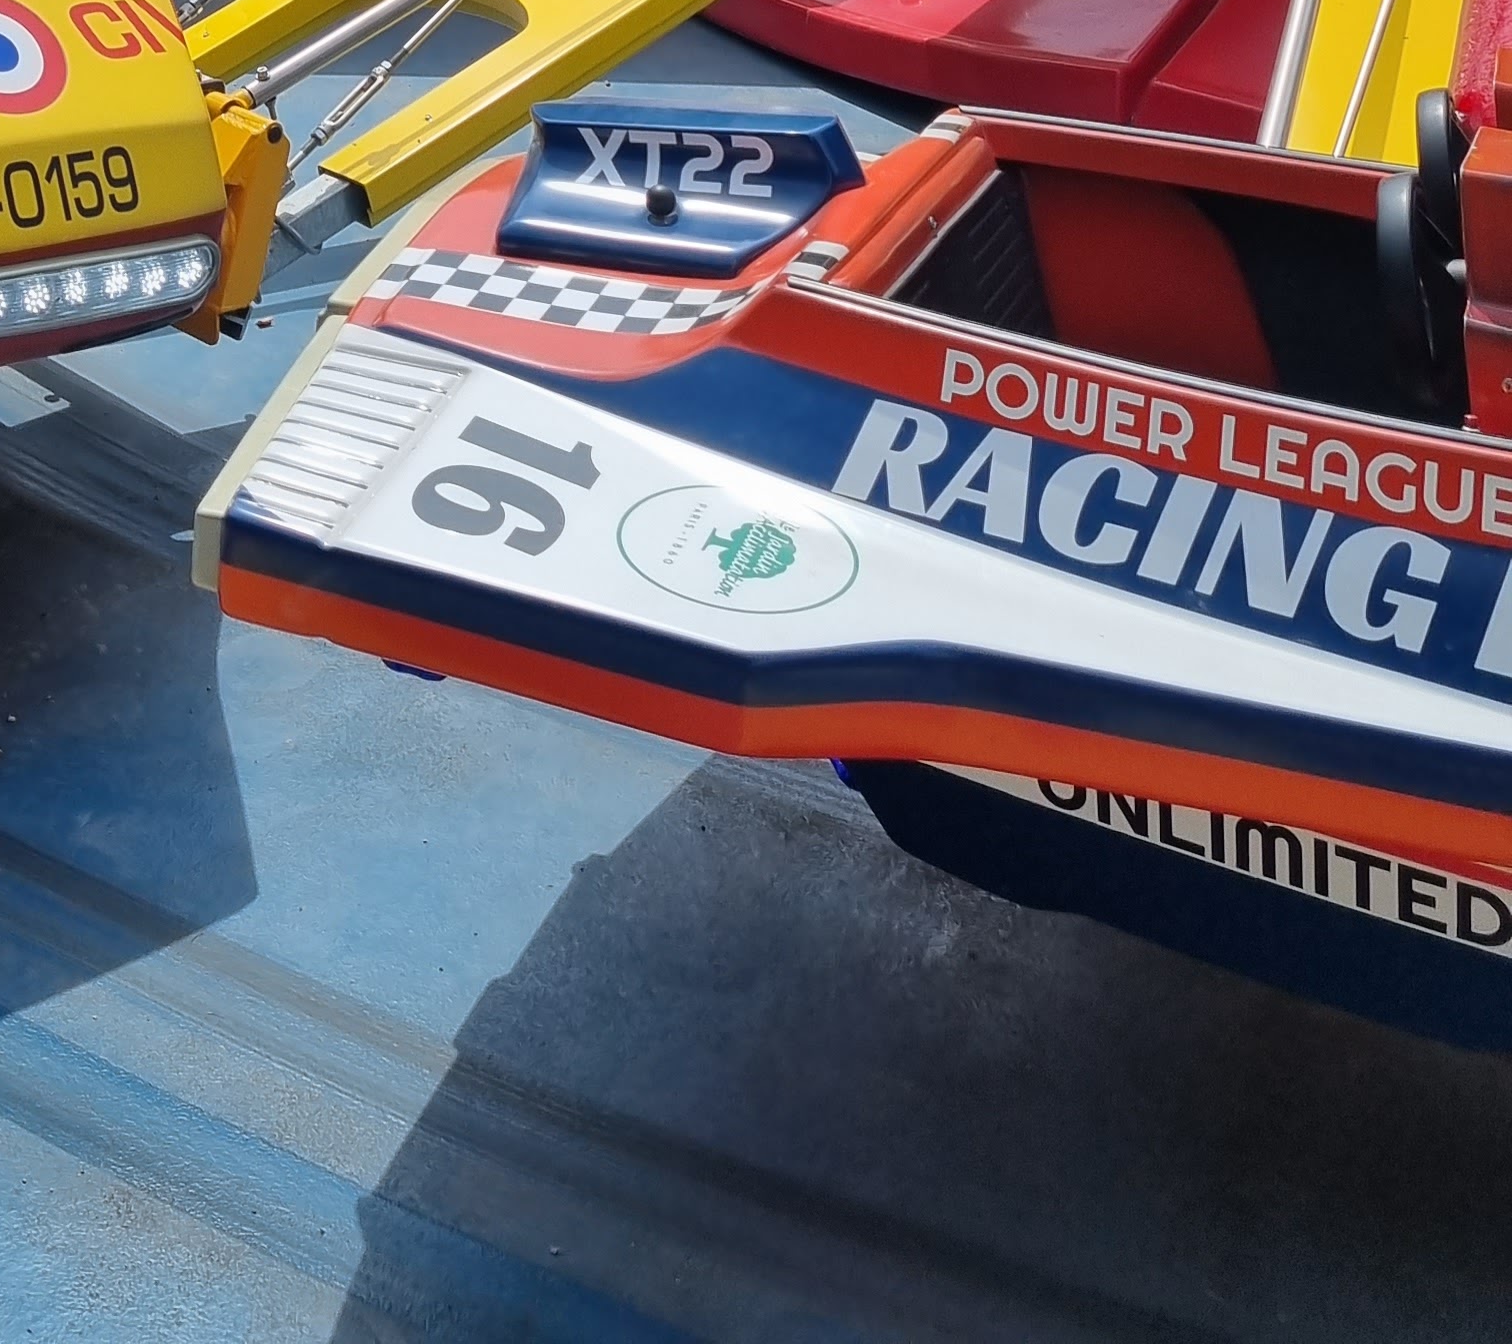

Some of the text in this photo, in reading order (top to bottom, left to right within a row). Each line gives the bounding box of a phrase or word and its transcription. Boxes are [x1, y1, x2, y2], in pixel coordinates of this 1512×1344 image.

[574, 127, 775, 198] XT22
[940, 348, 1194, 462] POWER
[411, 415, 602, 557] 16
[831, 398, 1453, 654] RACING
[753, 531, 790, 575] Jardin
